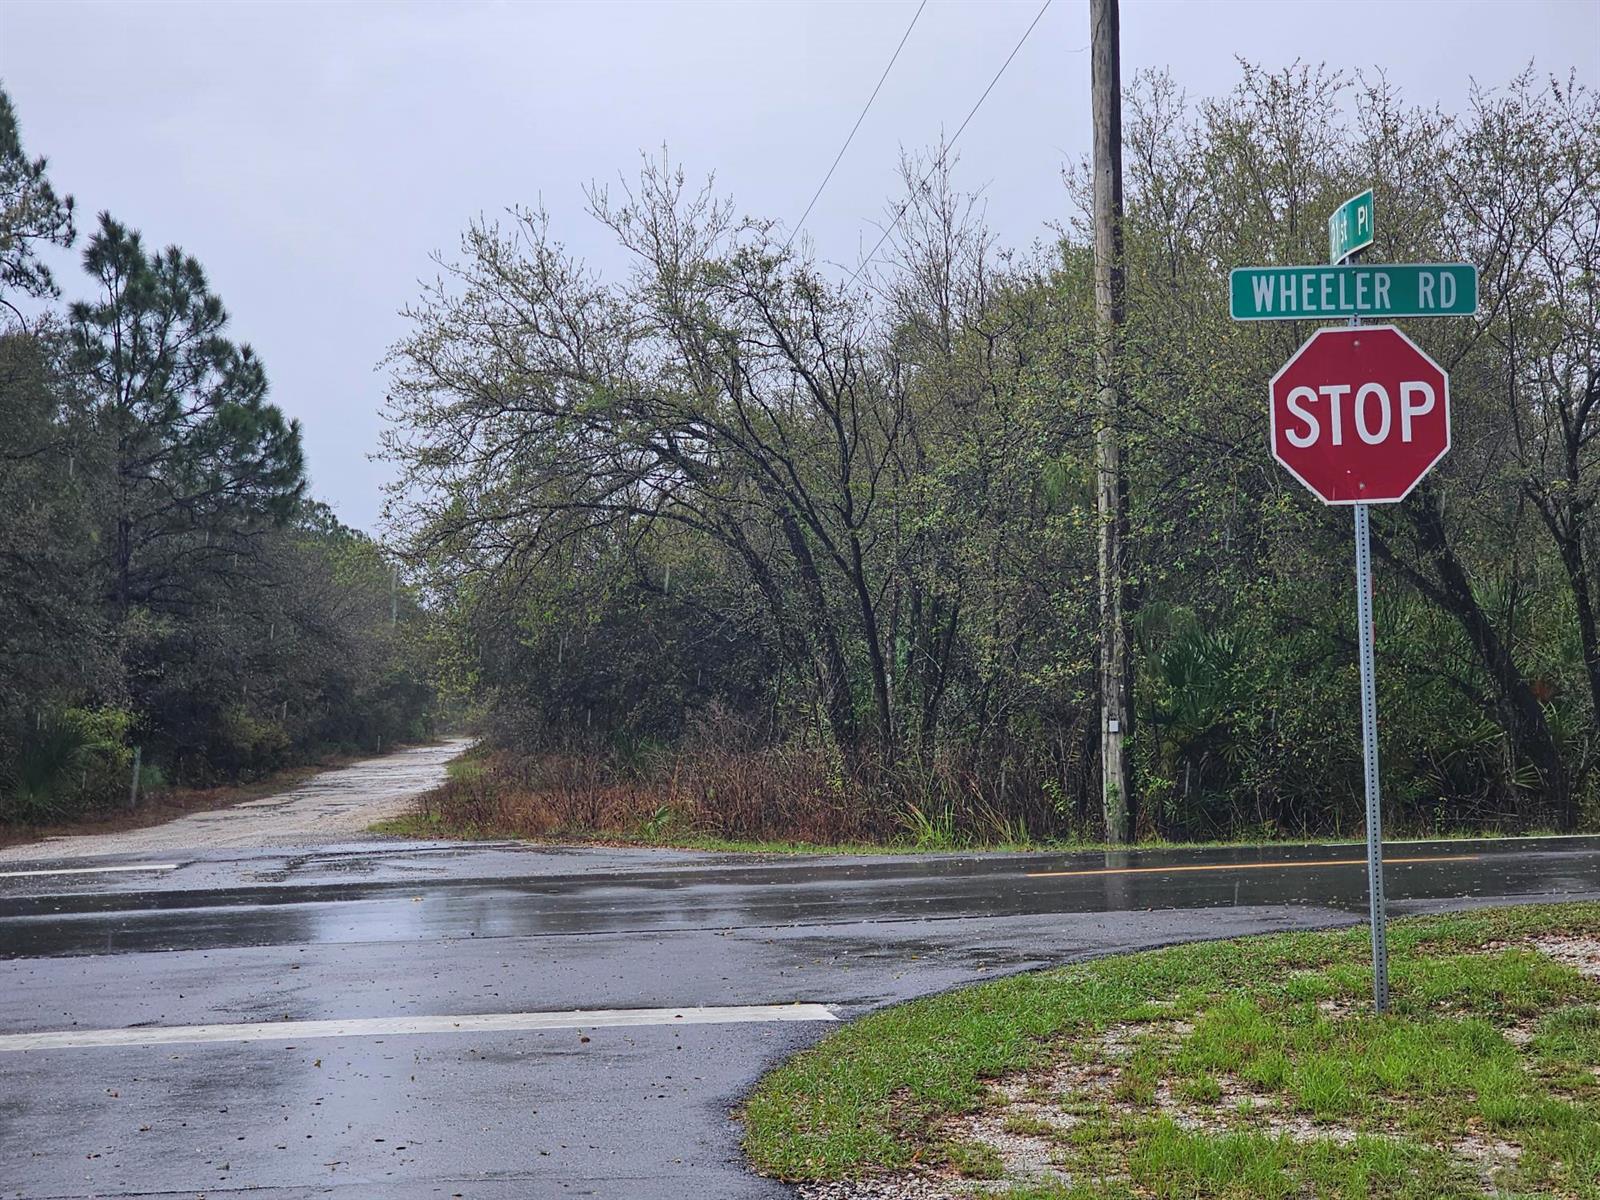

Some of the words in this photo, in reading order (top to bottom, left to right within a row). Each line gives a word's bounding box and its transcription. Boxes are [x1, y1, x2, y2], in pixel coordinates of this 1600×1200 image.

[1251, 272, 1391, 312] WHEELER
[1418, 271, 1457, 309] RD
[1285, 381, 1436, 448] STOP
